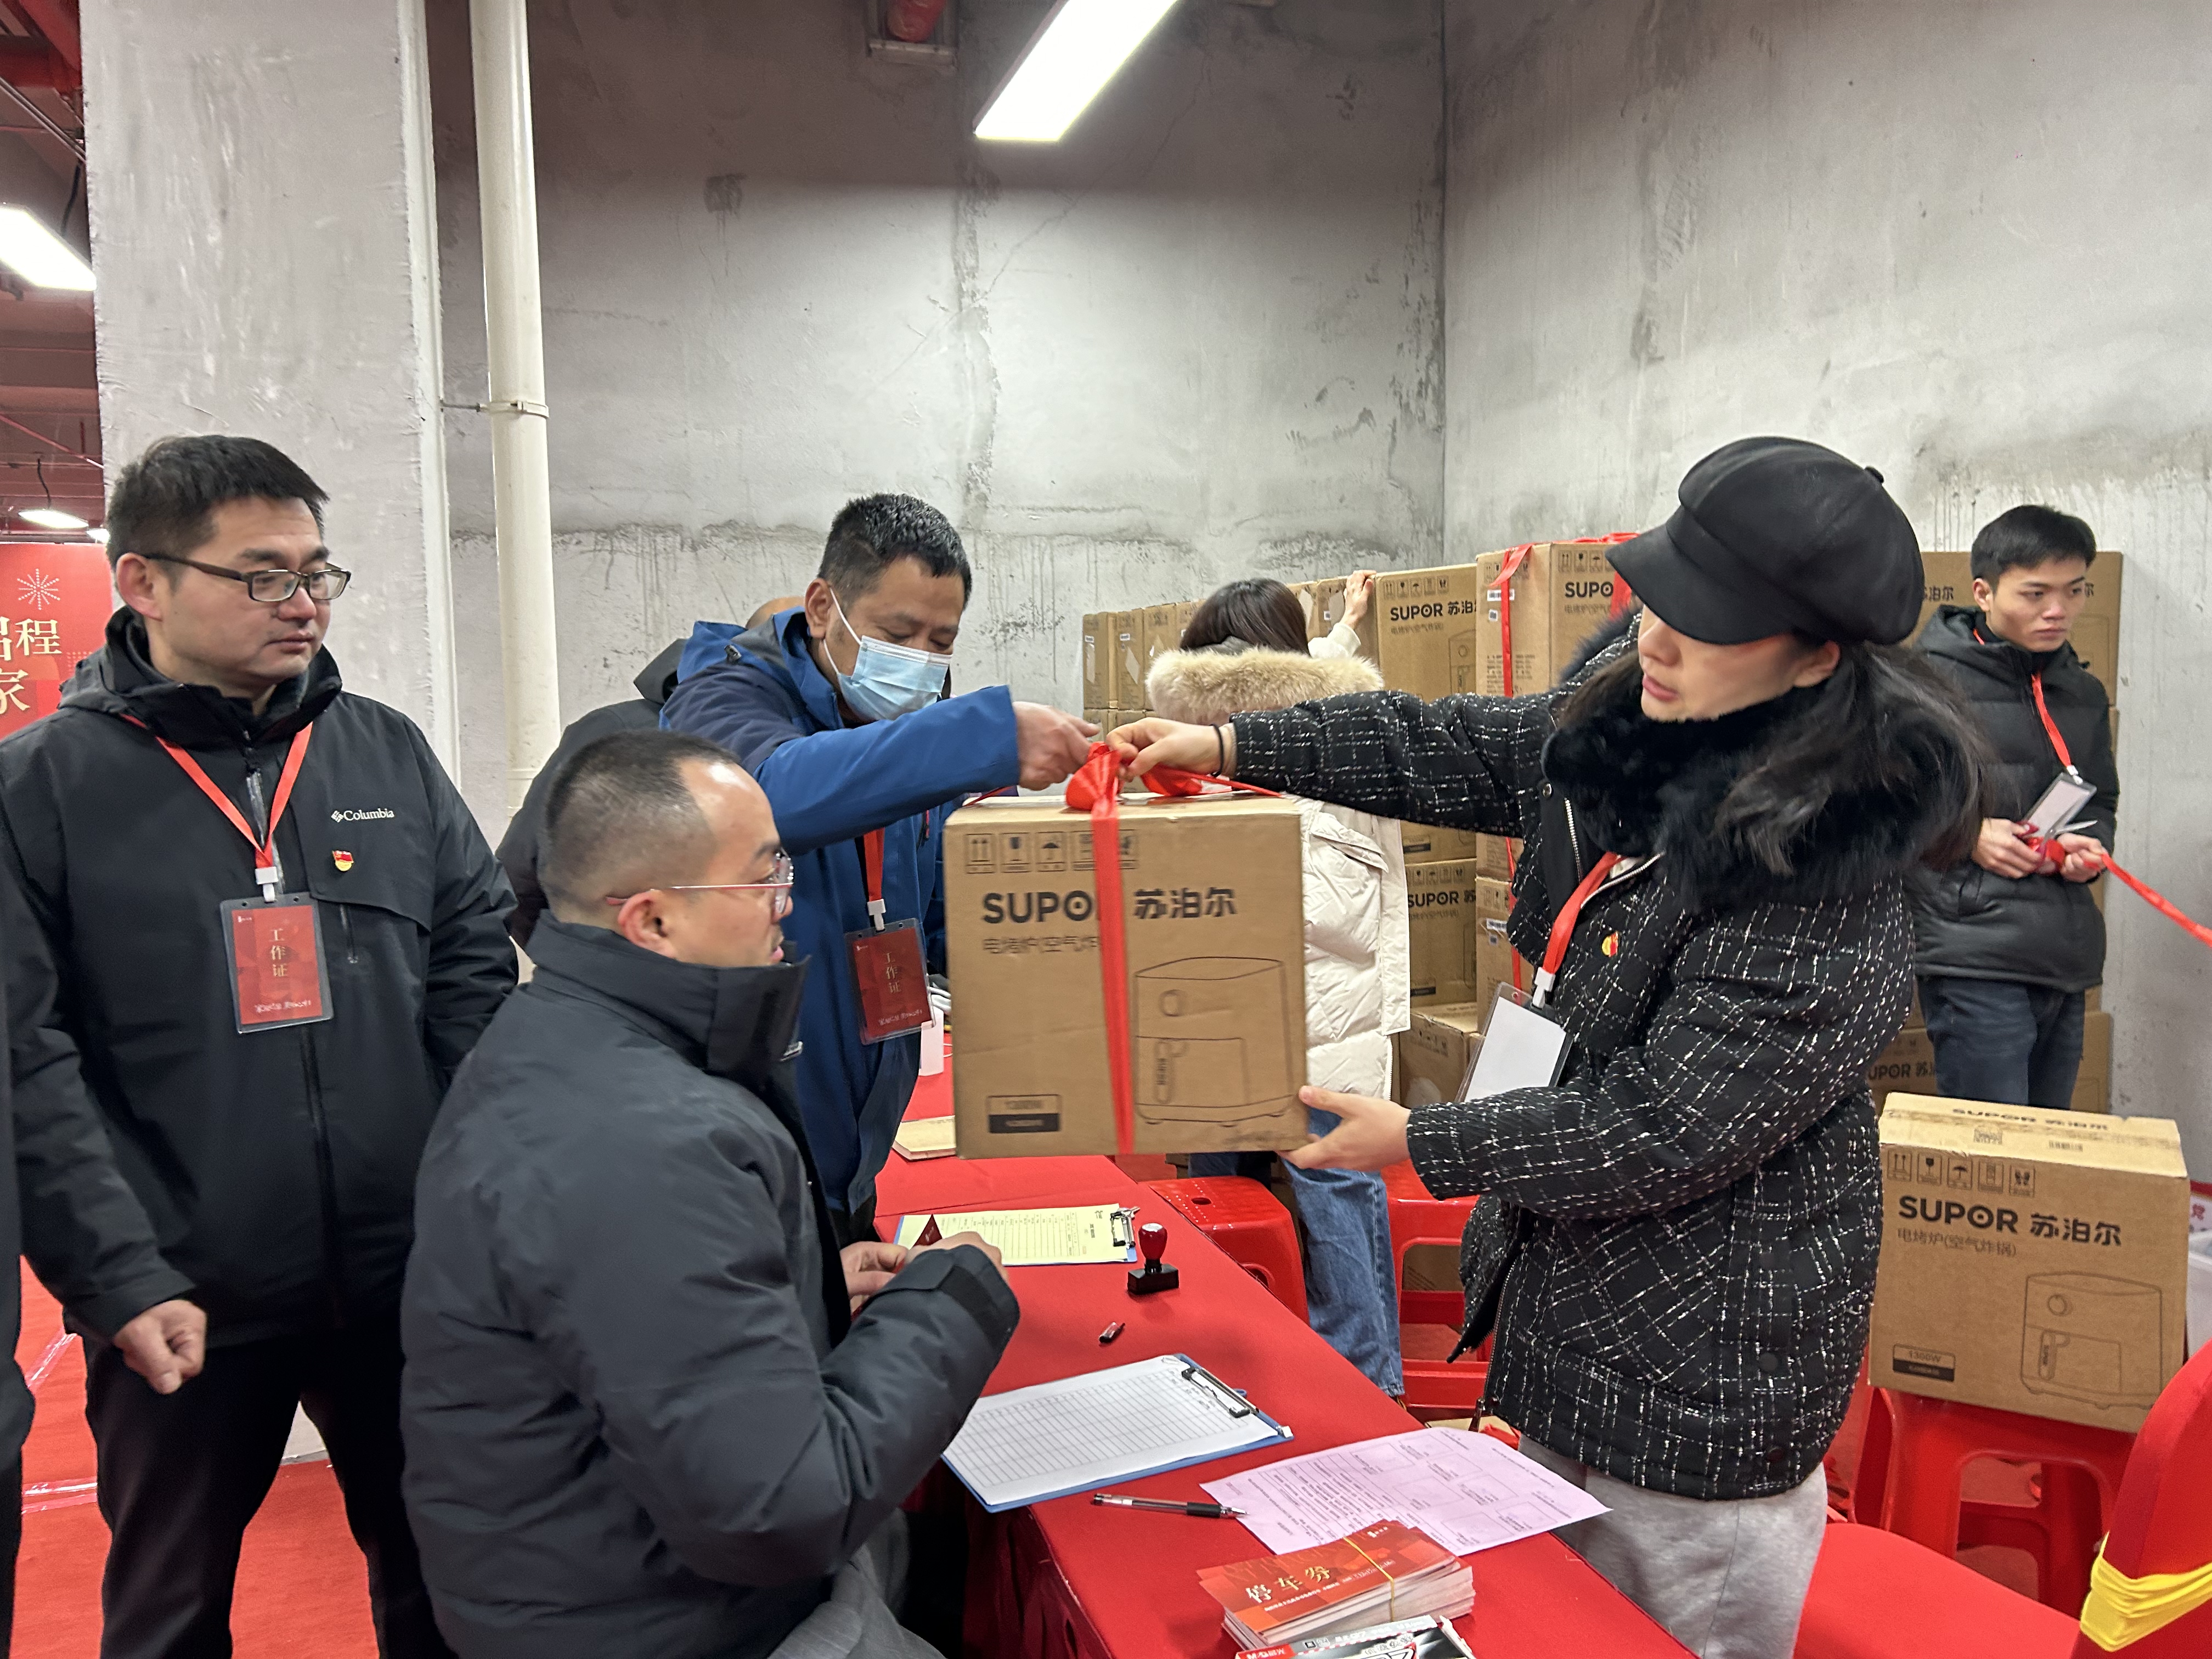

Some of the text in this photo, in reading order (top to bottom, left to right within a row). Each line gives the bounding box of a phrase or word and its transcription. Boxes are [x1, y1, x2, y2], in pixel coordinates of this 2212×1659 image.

[1565, 582, 1614, 598] SUPO
[1925, 585, 1954, 602] 泊尔
[1390, 599, 1476, 621] SUPOR 苏泊
[0, 616, 62, 661] 程
[343, 808, 394, 821] Columbia
[983, 887, 1238, 924] SUPO 苏泊尔
[1407, 890, 1459, 909] SUPOR
[882, 952, 902, 994] 工作证
[1867, 1063, 1910, 1080] UPOR
[1898, 1195, 2122, 1246] SUPOR 苏泊尔
